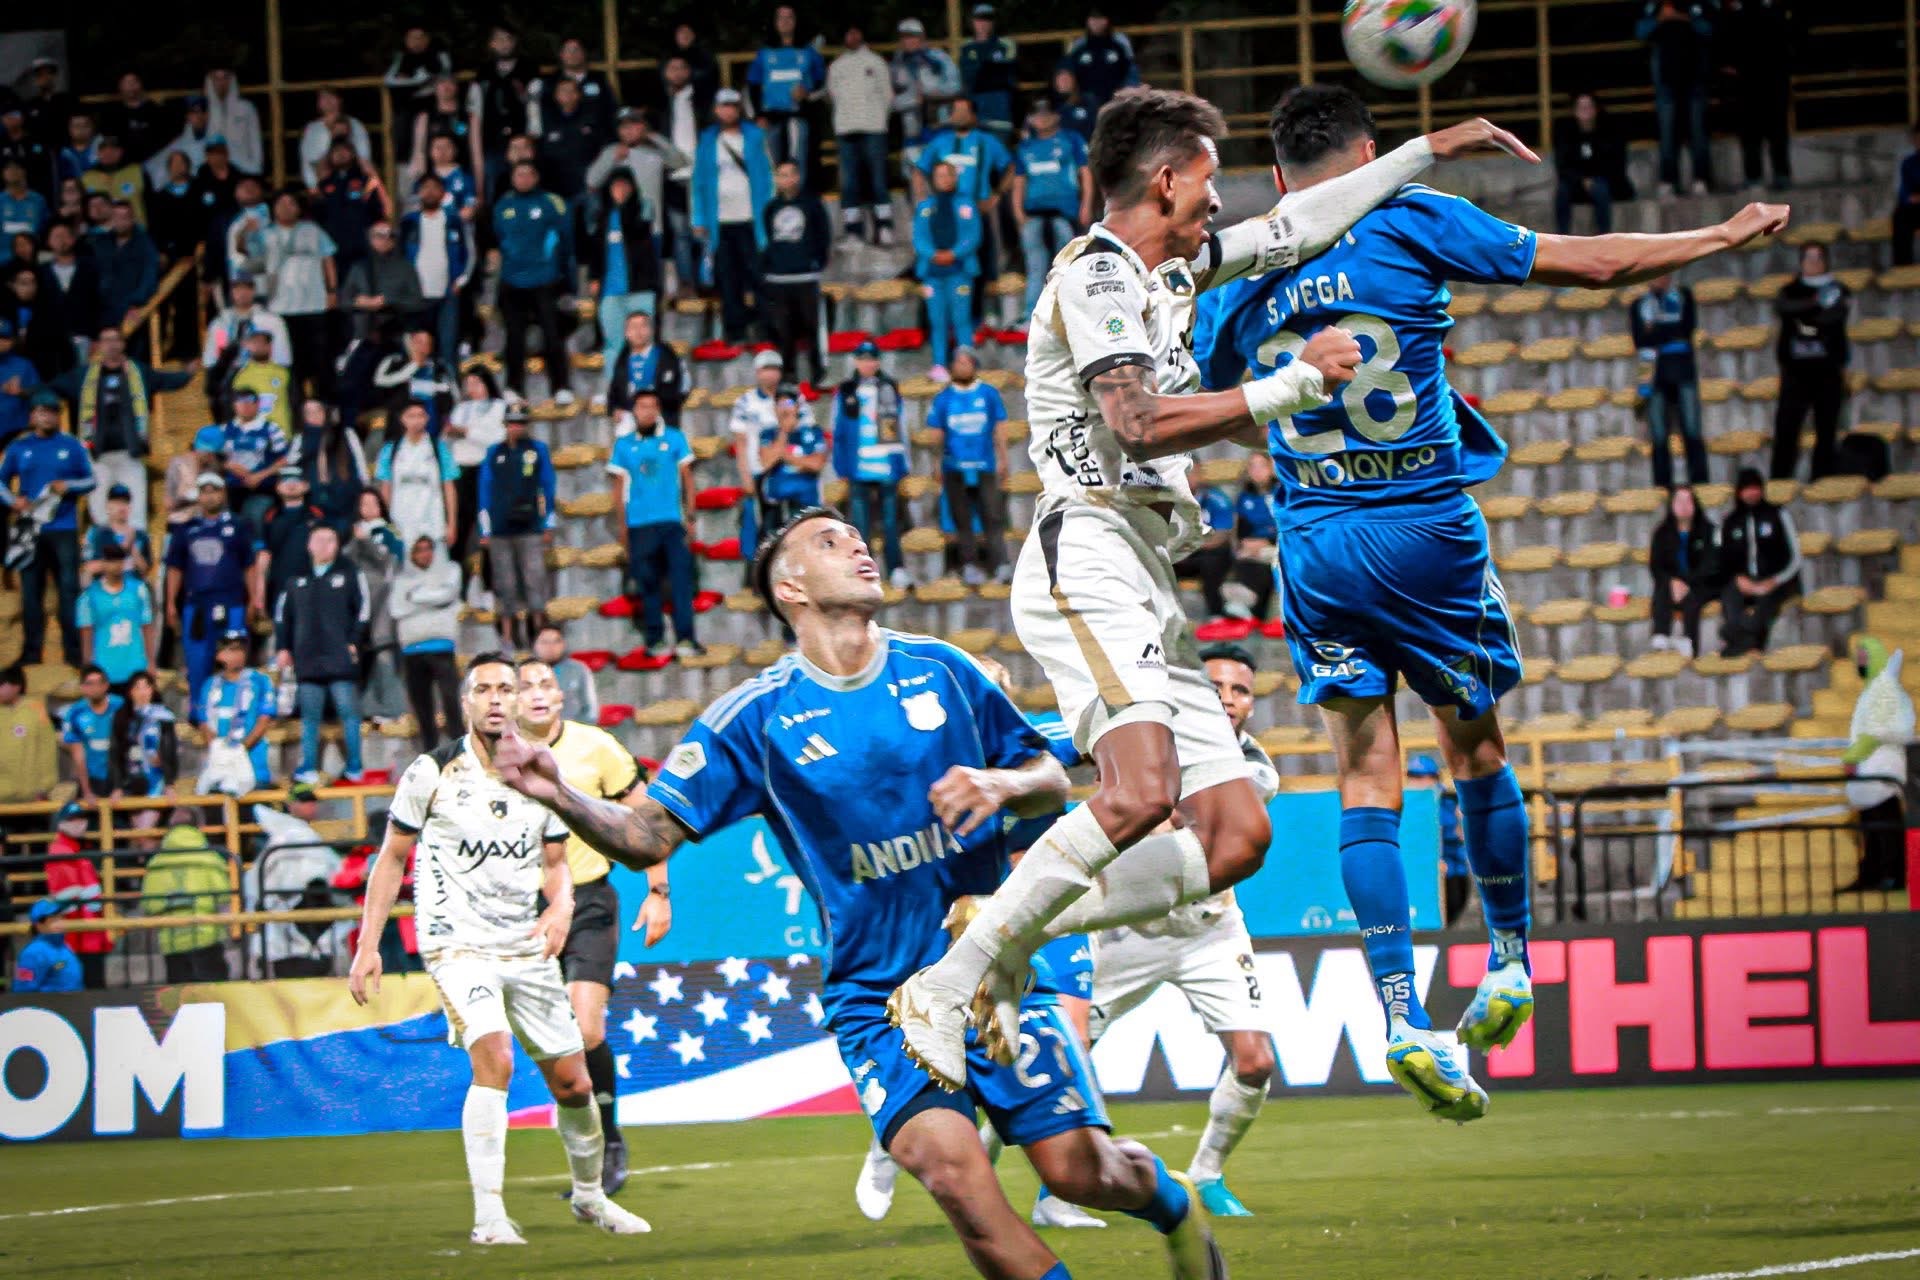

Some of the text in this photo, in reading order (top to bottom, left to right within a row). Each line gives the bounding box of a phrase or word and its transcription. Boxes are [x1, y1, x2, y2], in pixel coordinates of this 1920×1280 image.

[1266, 271, 1355, 326] S. VEGA
[1256, 313, 1418, 455] 28
[1311, 657, 1368, 678] GAC
